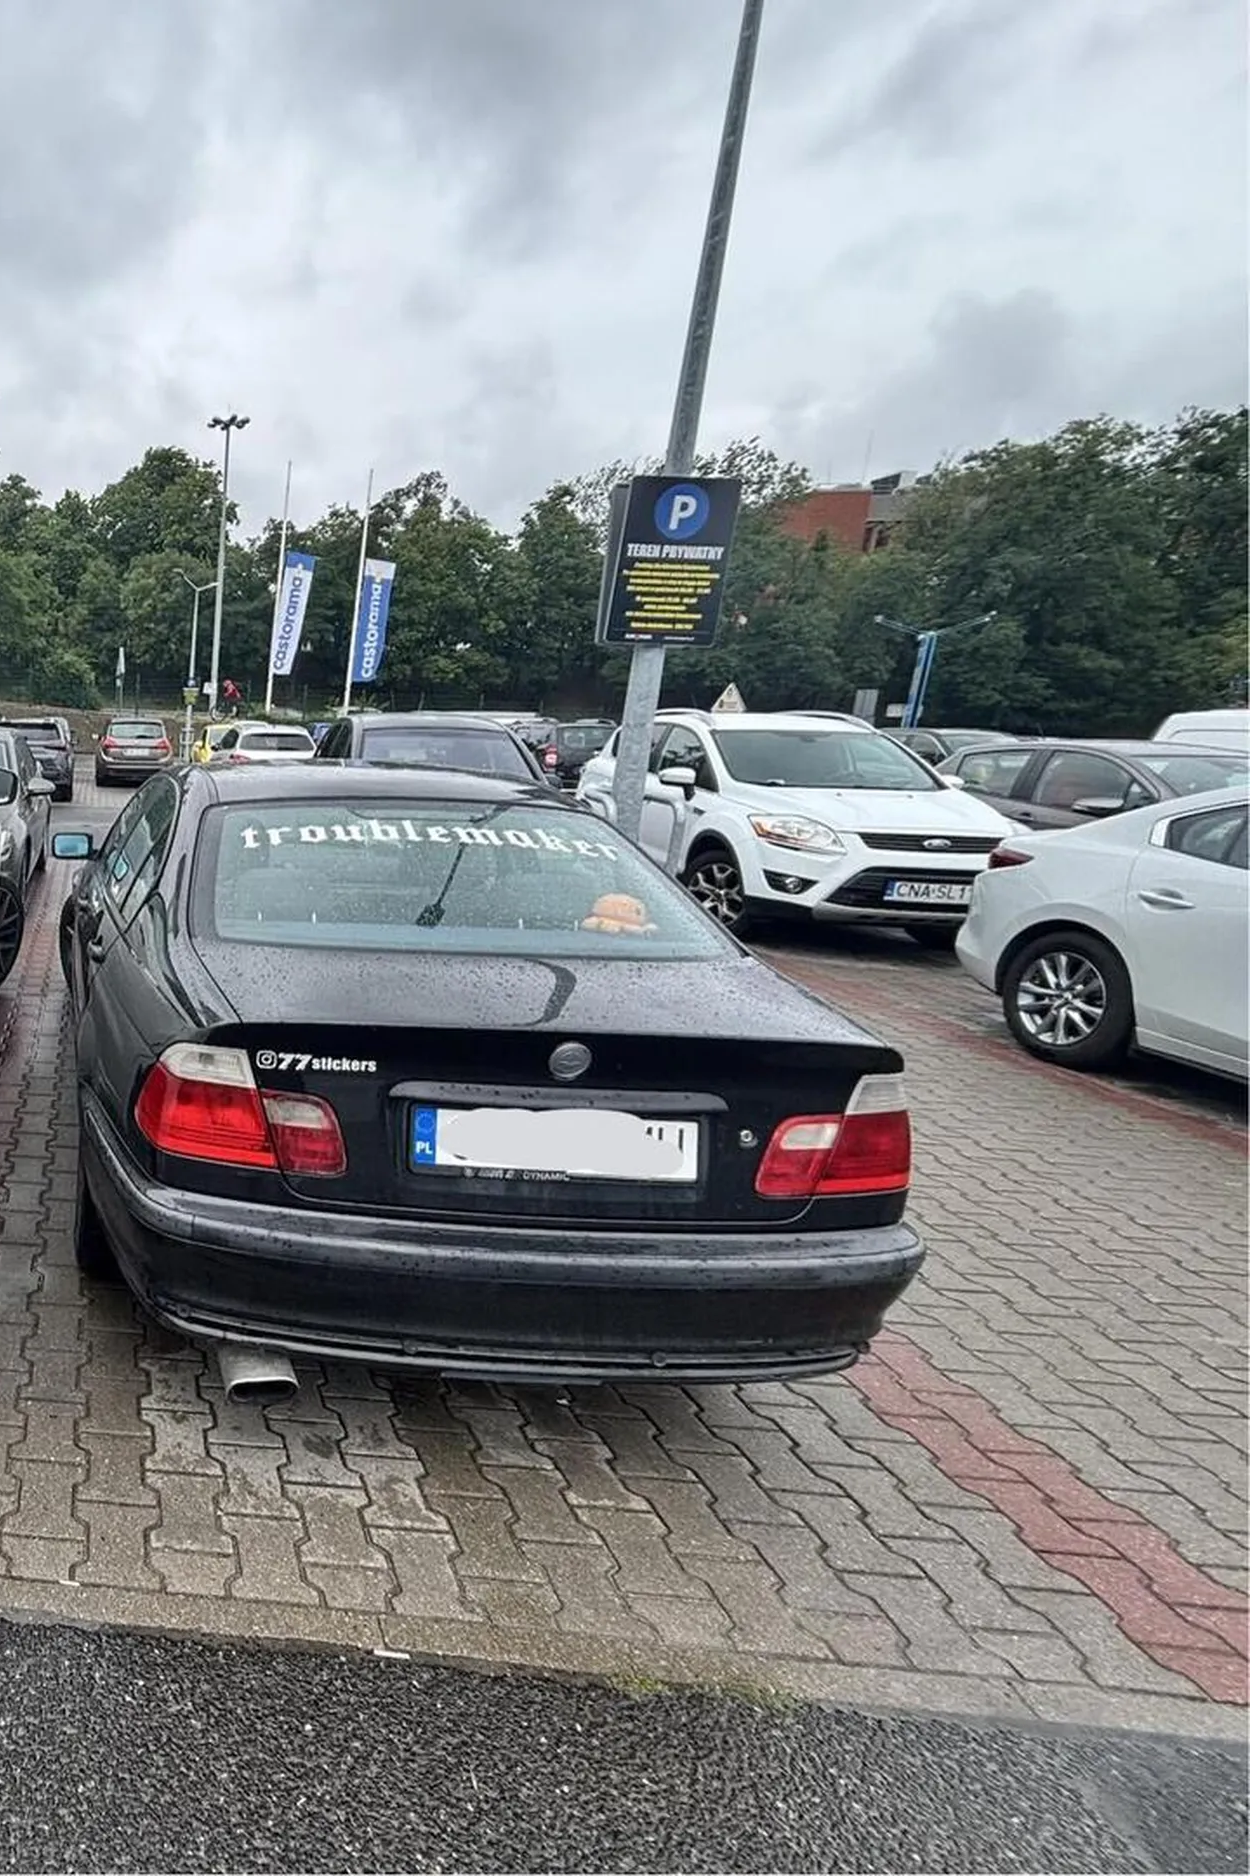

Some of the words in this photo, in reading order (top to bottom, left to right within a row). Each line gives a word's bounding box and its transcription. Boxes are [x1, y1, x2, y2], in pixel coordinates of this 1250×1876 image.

[668, 494, 698, 531] P
[627, 543, 661, 558] TEREN
[273, 576, 303, 670] castorama
[361, 583, 382, 678] castorama
[240, 819, 619, 861] troublemaker
[416, 1141, 433, 1154] PL
